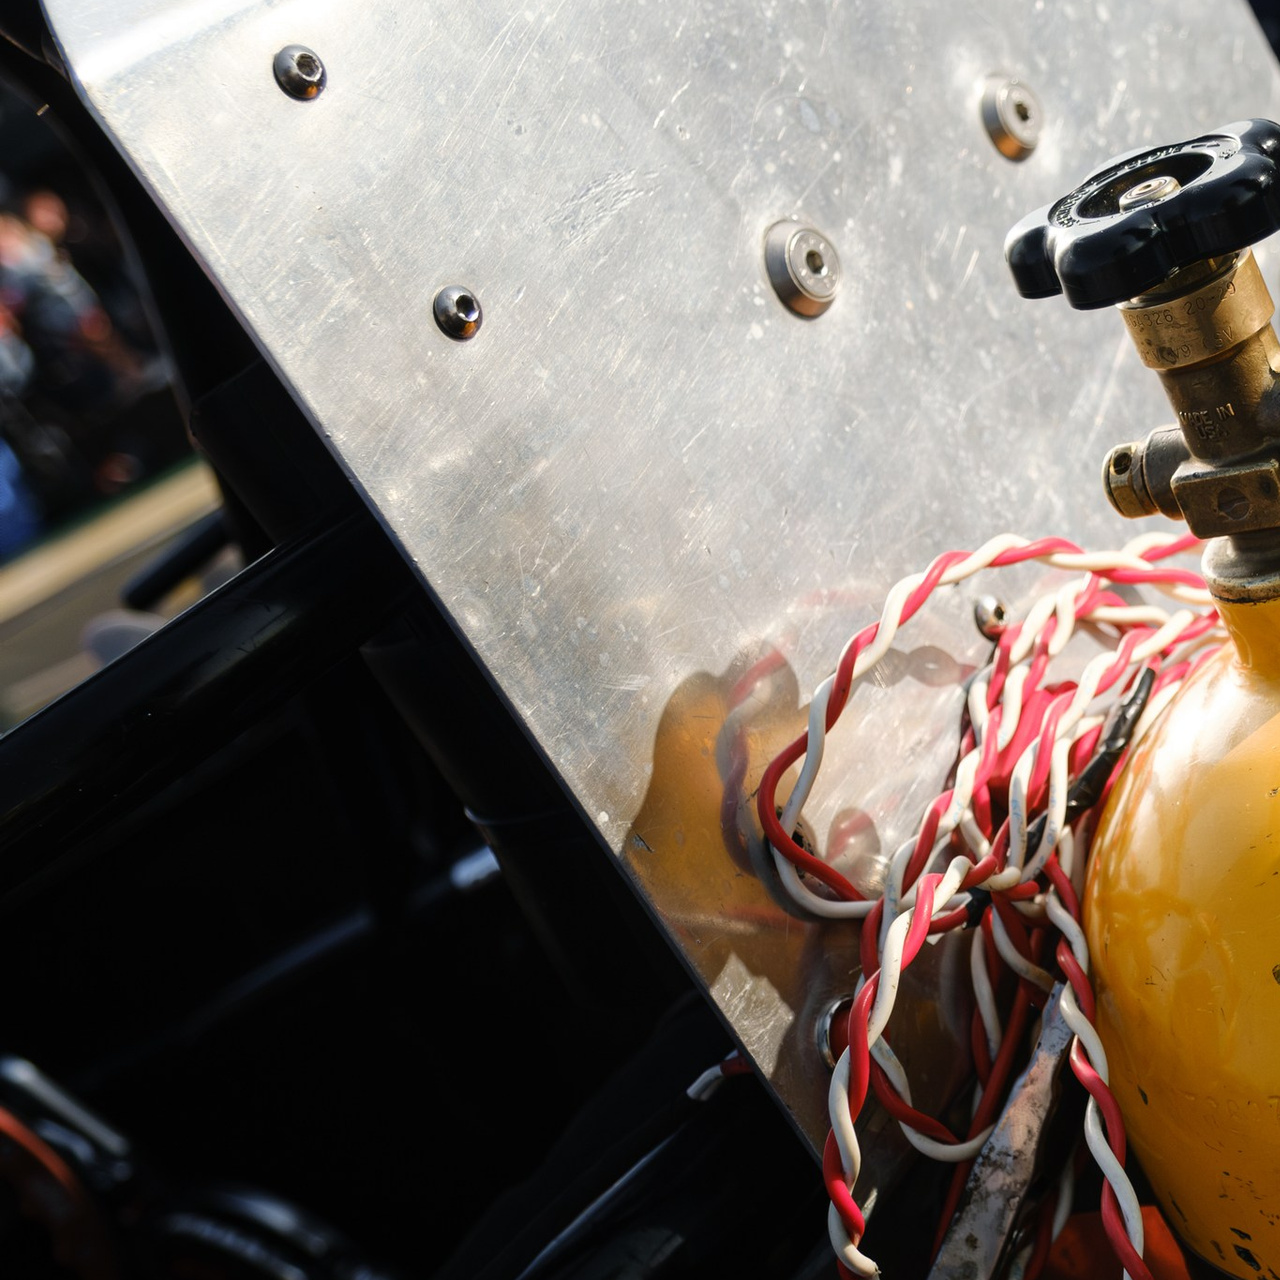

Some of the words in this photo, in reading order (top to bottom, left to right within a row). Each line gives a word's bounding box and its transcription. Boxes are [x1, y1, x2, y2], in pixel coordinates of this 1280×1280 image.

[1178, 410, 1213, 427] MADE
[1215, 402, 1236, 421] IN
[1195, 424, 1230, 440] USA
